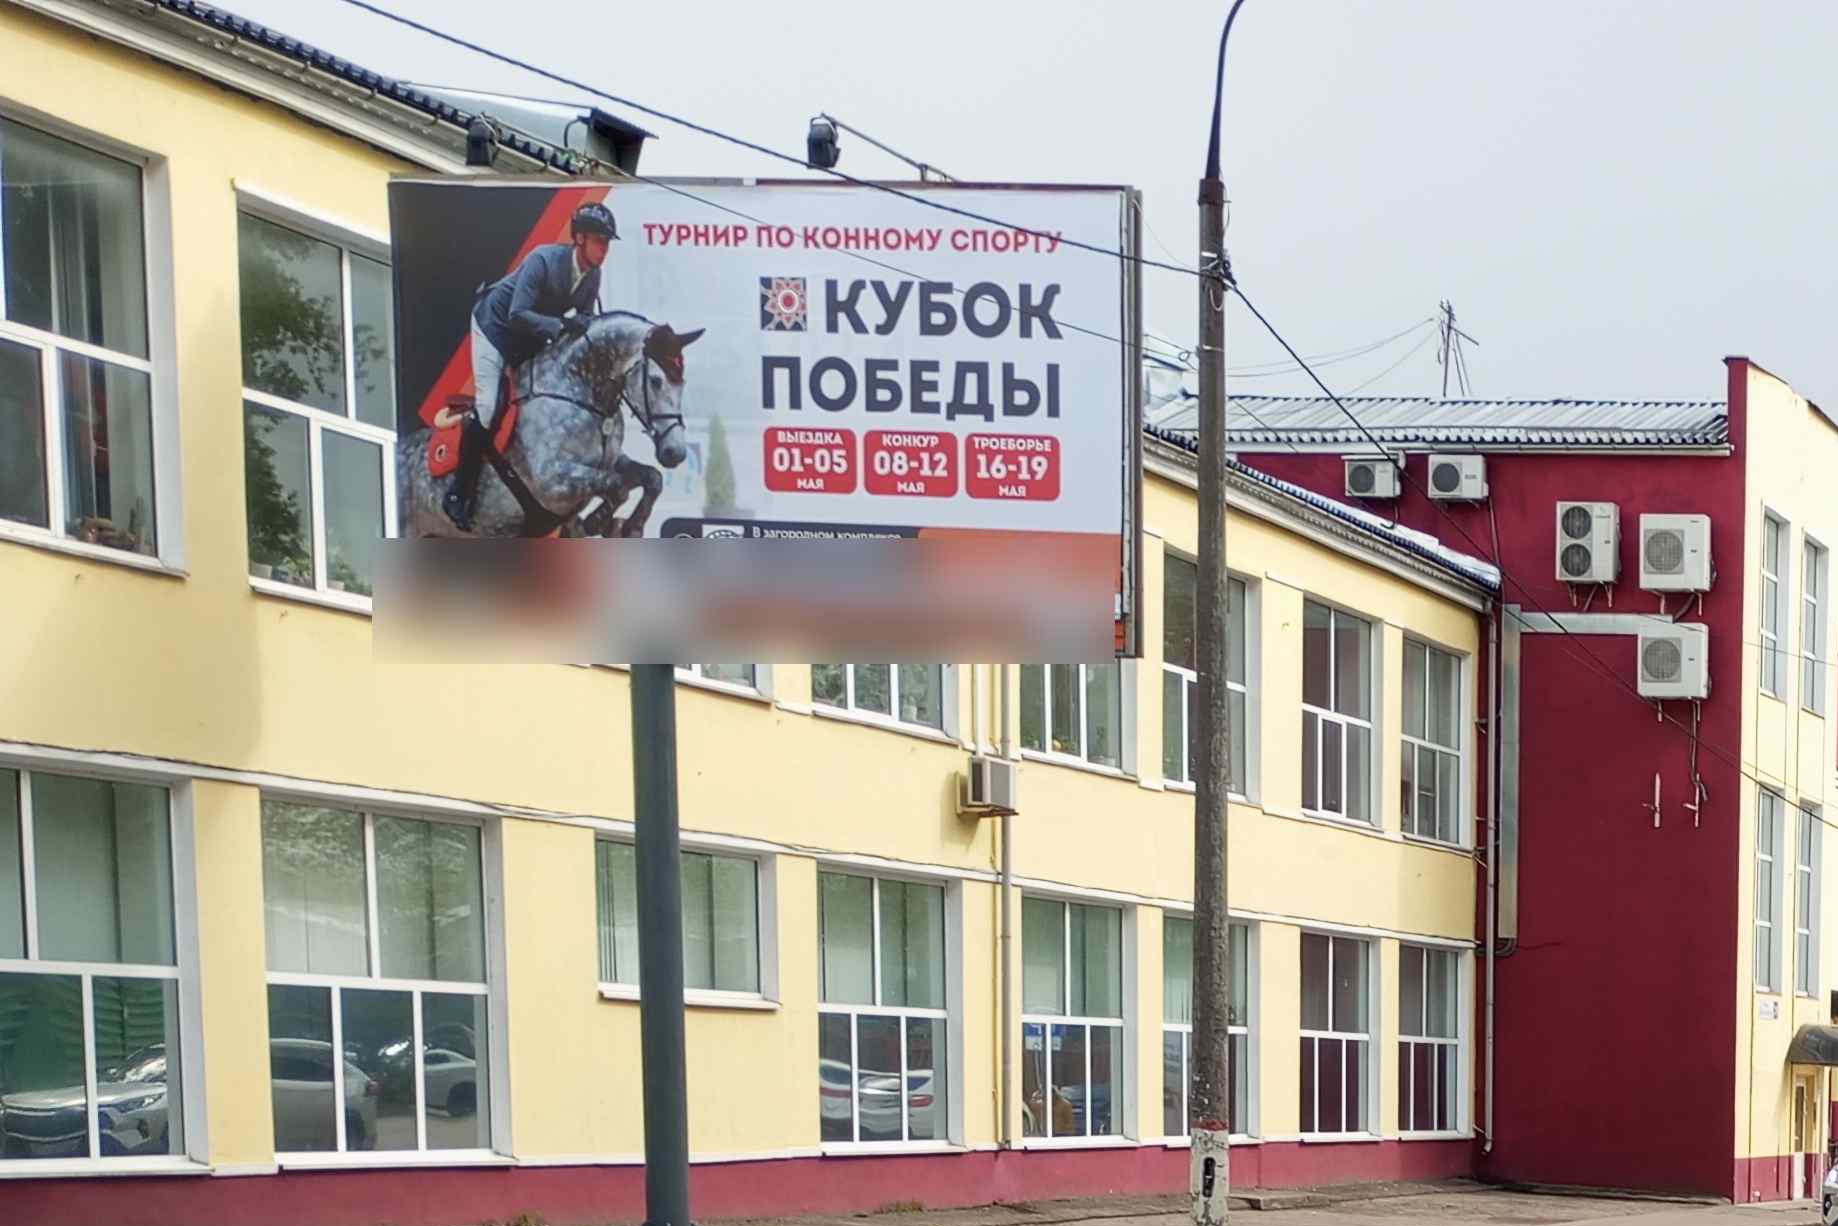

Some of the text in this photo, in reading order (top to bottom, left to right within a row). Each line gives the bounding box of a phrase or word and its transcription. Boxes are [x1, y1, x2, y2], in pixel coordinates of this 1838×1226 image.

[643, 223, 1062, 253] ТУРНИР ПО КОННОМУ СПОРТУ
[825, 279, 1063, 339] КУБОК
[761, 356, 1060, 422] ПОБЕДЫ
[777, 431, 844, 445] ВЫЕЗДКА
[882, 434, 939, 448] КОНКУР
[973, 437, 1052, 452] ТРОЕБОРЬЕ
[773, 447, 848, 473] 01-05
[873, 450, 948, 477] 08-12
[976, 453, 1049, 480] 16-19
[797, 478, 825, 490] МАЯ
[897, 481, 925, 493] МАЯ
[998, 484, 1027, 497] МАЯ
[752, 526, 760, 538] В
